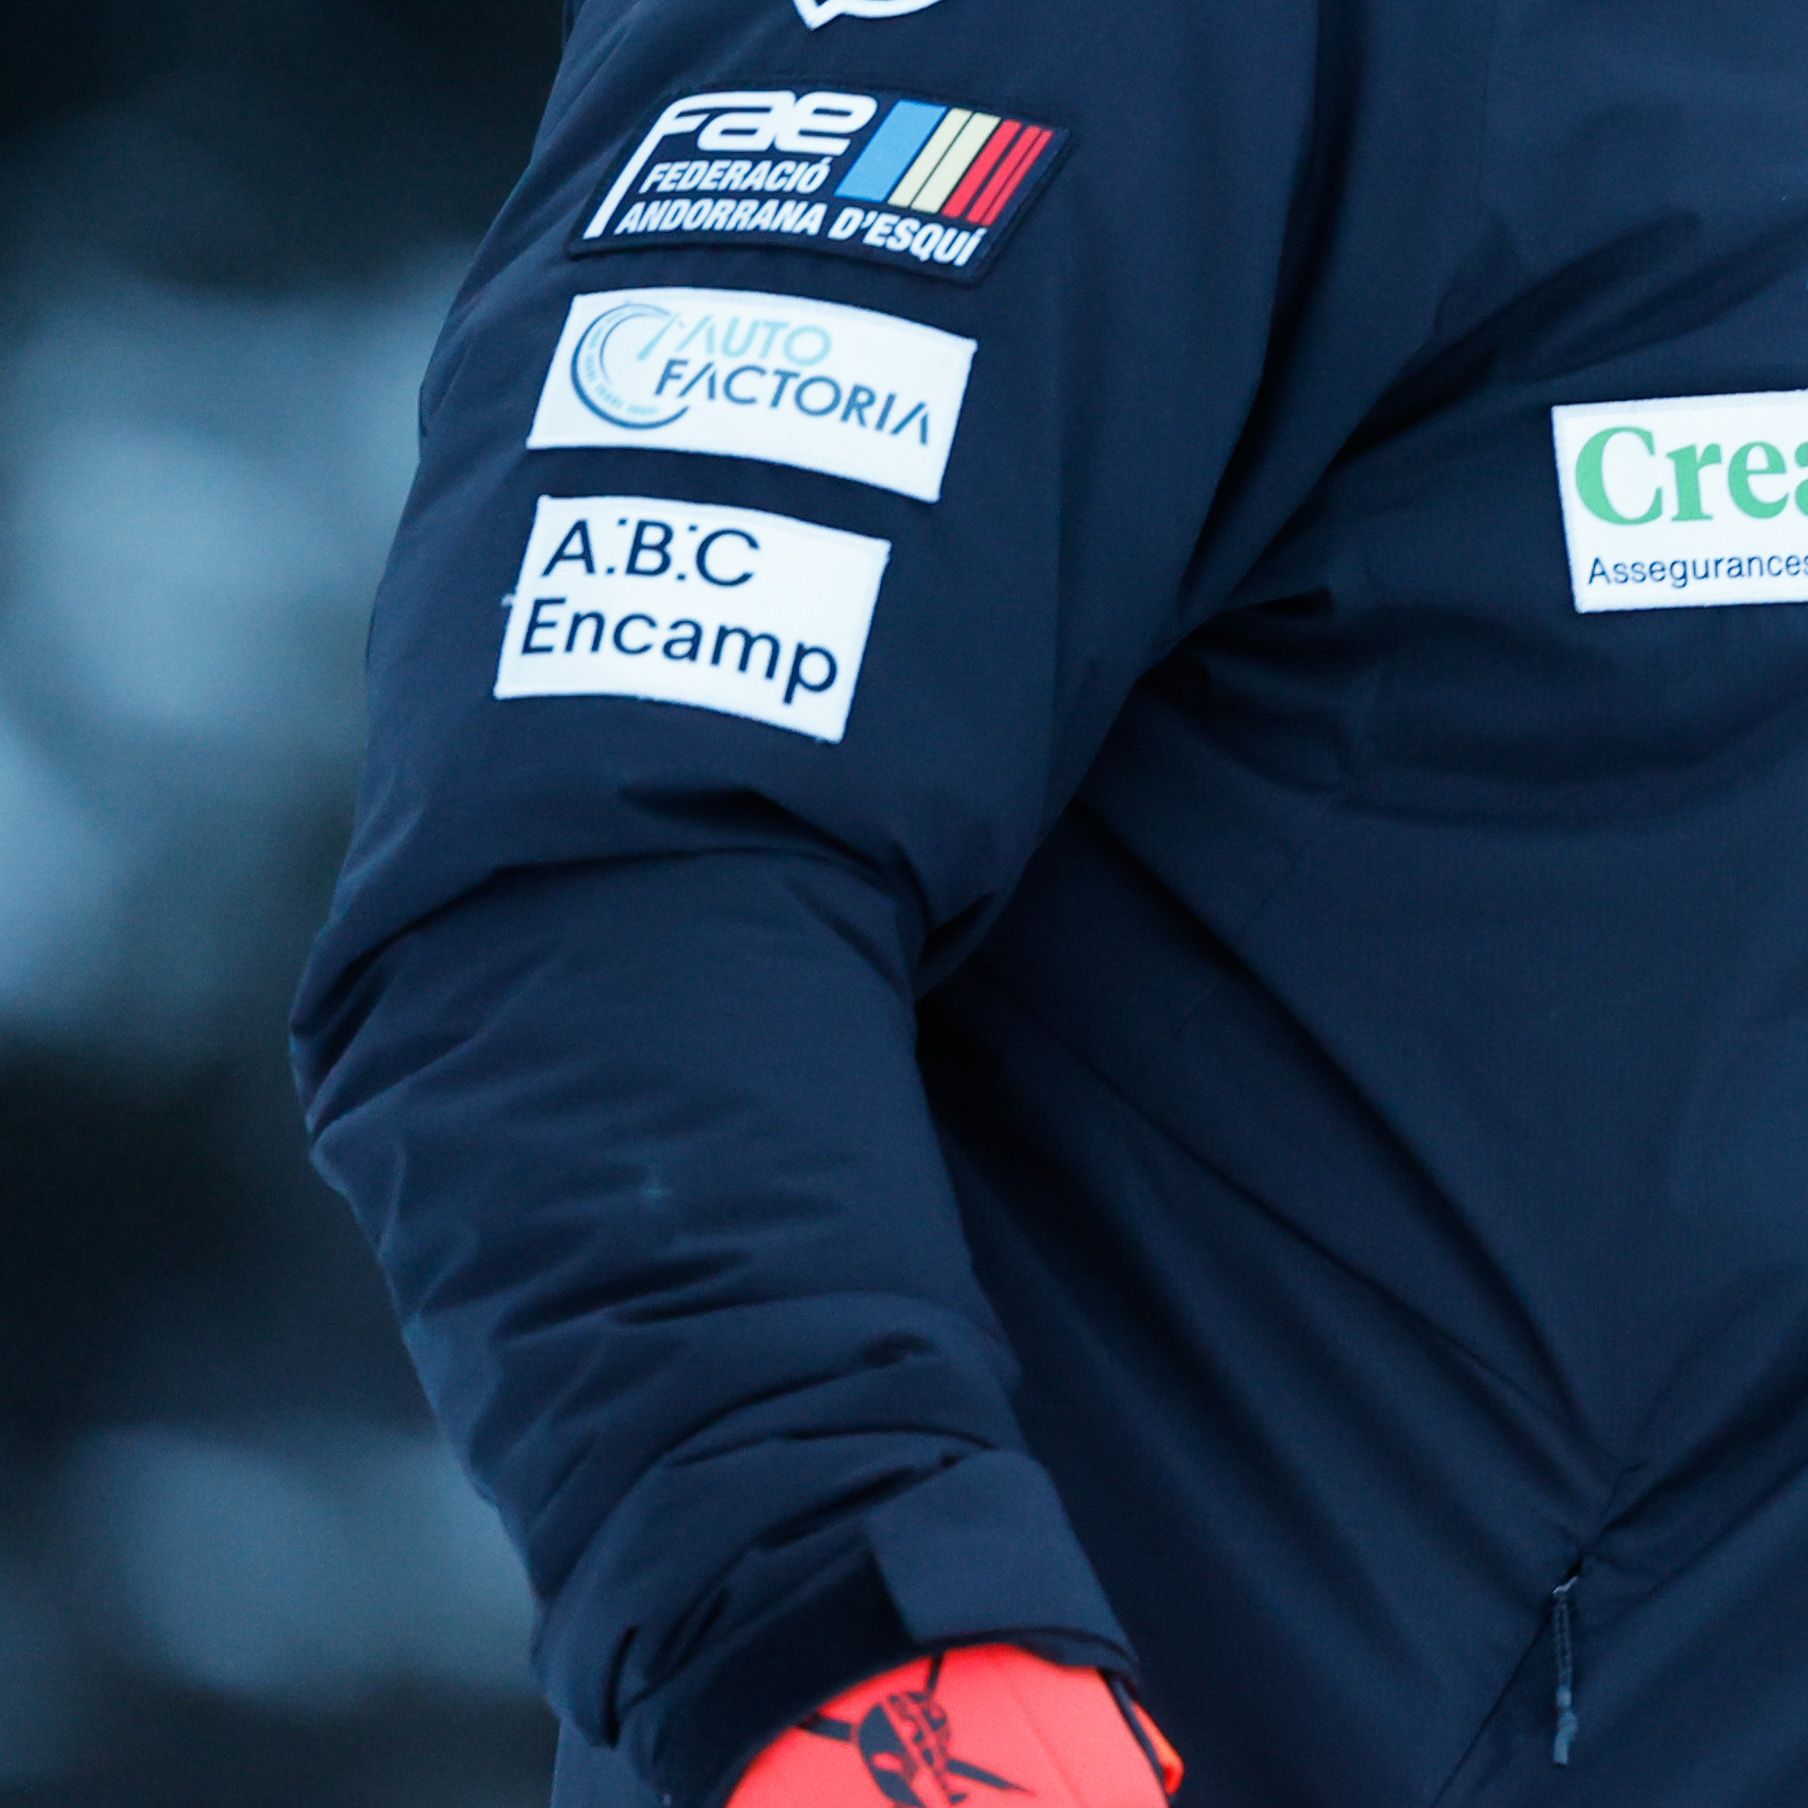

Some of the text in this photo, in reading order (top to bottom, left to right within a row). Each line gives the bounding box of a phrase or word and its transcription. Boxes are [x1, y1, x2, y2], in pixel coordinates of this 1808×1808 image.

[639, 156, 832, 195] FEDERACIÓ
[613, 198, 988, 267] ANDORRANA D'ESQUÍ
[675, 314, 832, 367] AUTO
[654, 357, 930, 447] FACTORIA
[521, 597, 838, 705] Encamp
